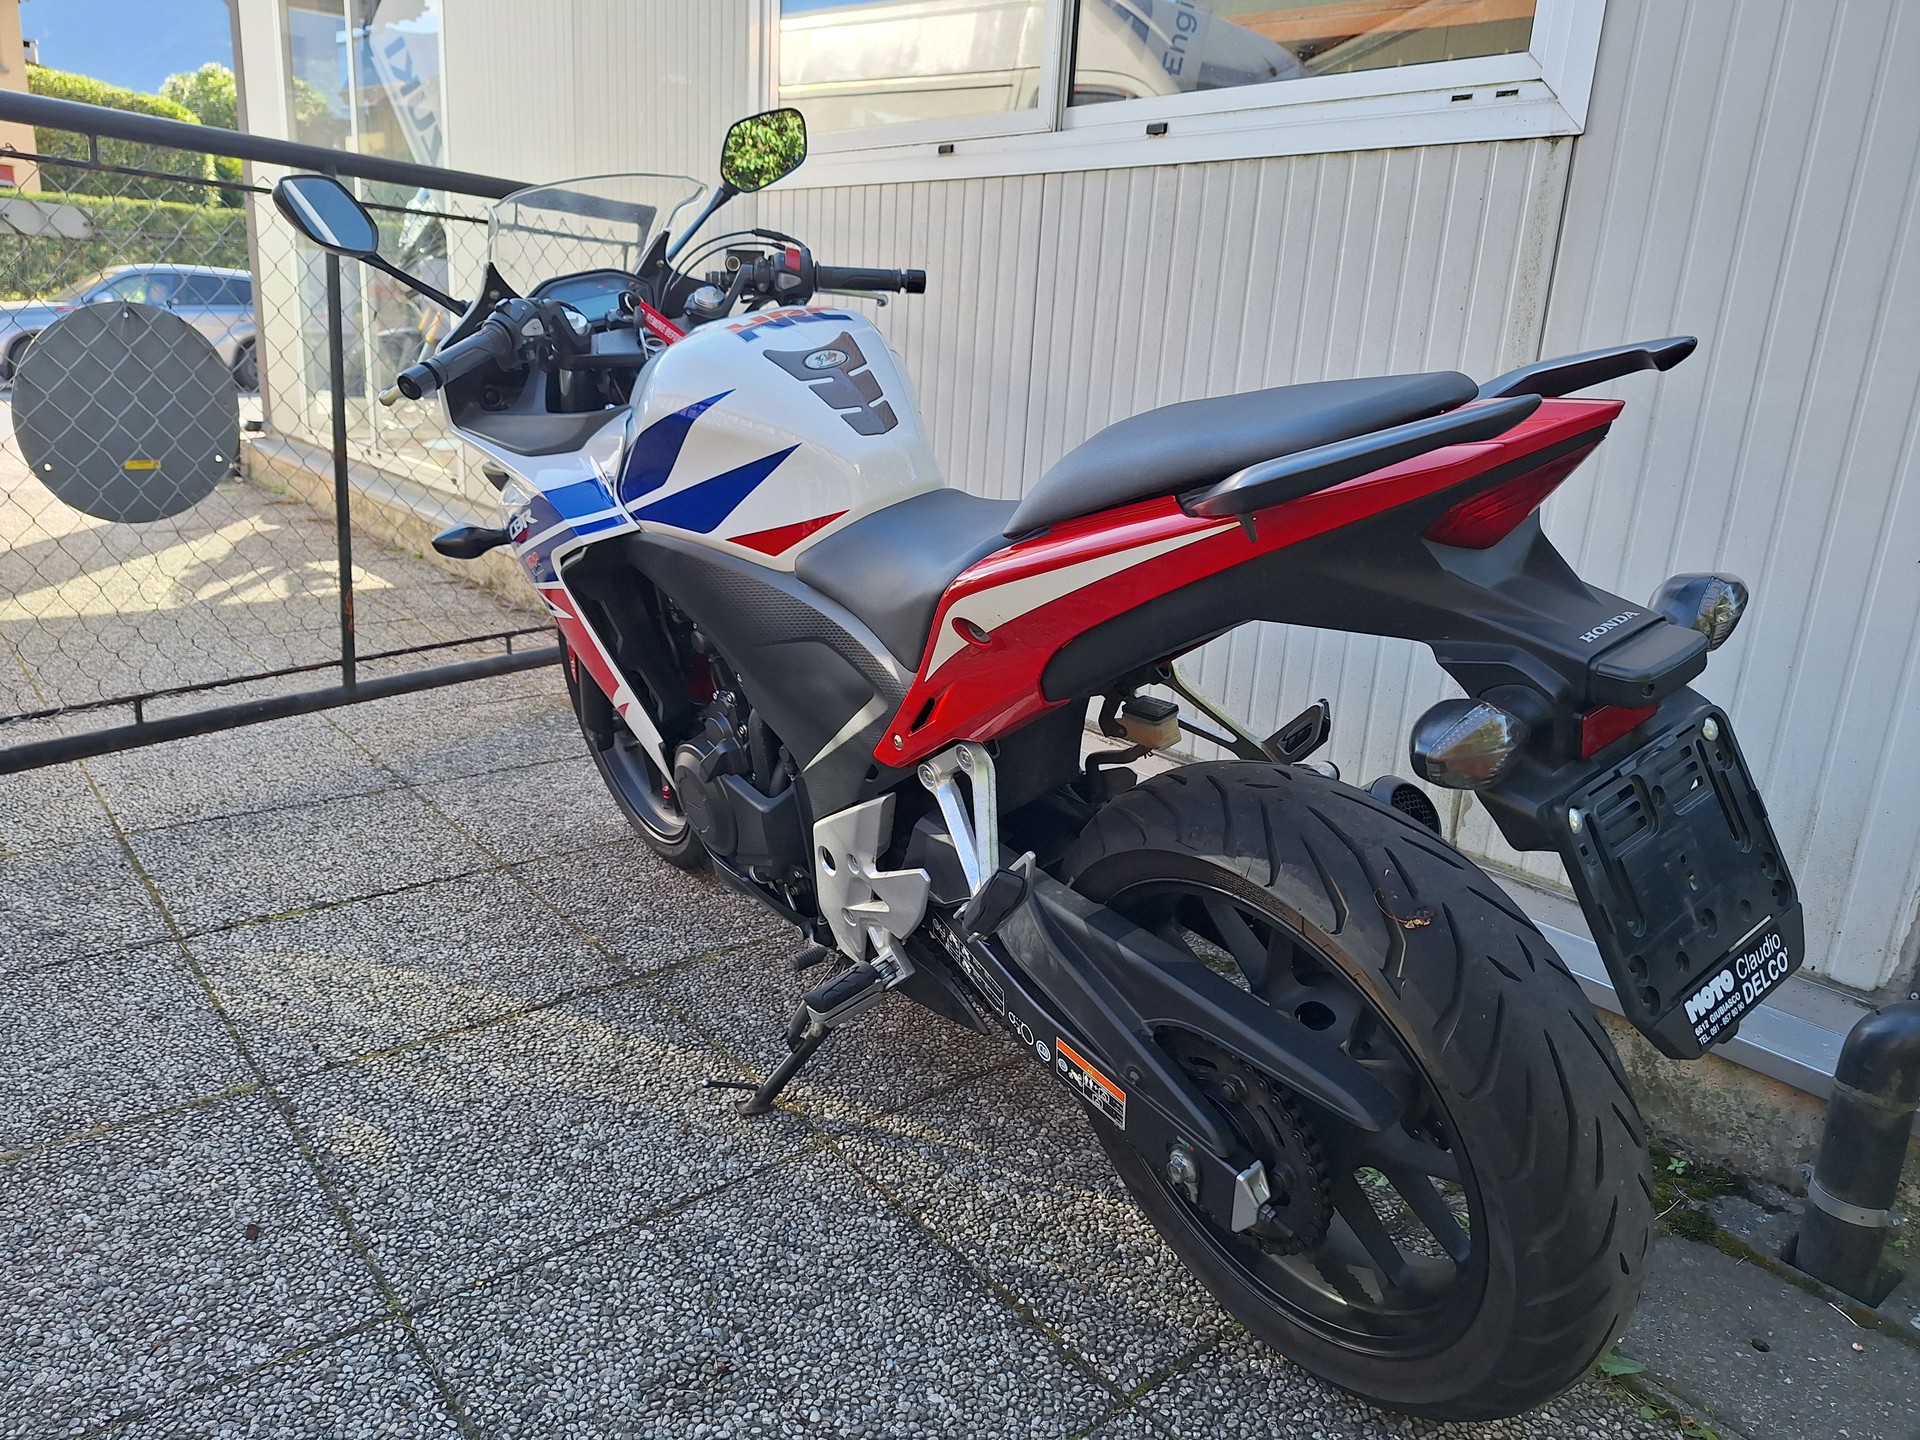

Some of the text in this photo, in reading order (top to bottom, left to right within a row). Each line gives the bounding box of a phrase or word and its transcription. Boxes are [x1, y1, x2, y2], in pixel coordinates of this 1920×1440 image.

[509, 508, 538, 541] CBR
[1578, 611, 1640, 643] HONDA
[1684, 933, 1781, 1024] MOTO Claudio
[1694, 992, 1741, 1037] 6512 GIUBIASCO
[1710, 1023, 1720, 1036] 091
